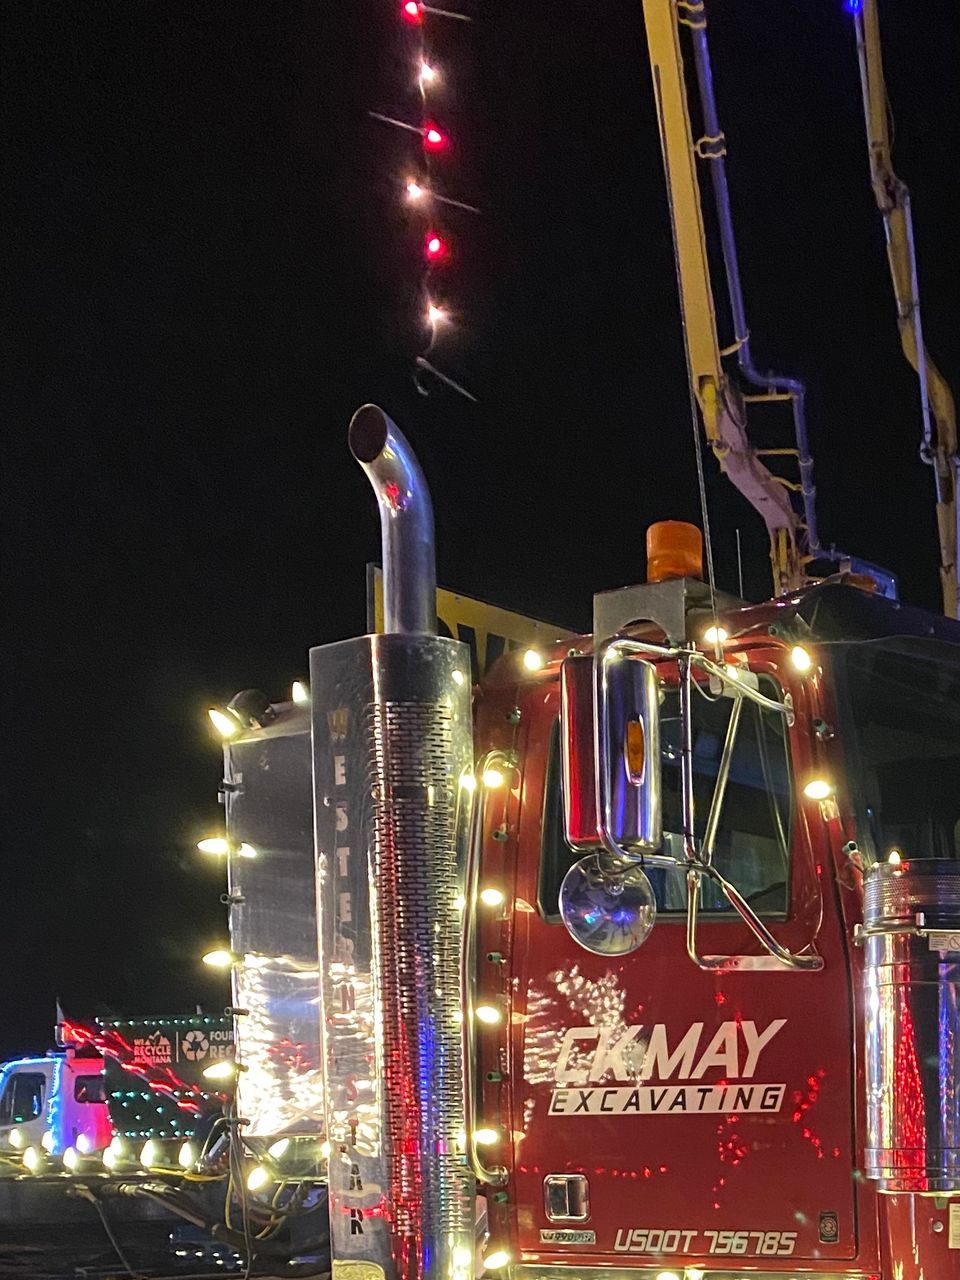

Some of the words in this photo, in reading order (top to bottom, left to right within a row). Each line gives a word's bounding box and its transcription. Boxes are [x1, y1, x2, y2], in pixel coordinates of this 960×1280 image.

[133, 1045, 172, 1056] RECYCLE
[133, 1055, 172, 1064] MONTANA
[551, 1086, 782, 1113] EXCAVATING
[613, 1228, 698, 1253] USDOT
[703, 1230, 798, 1255] 756785
